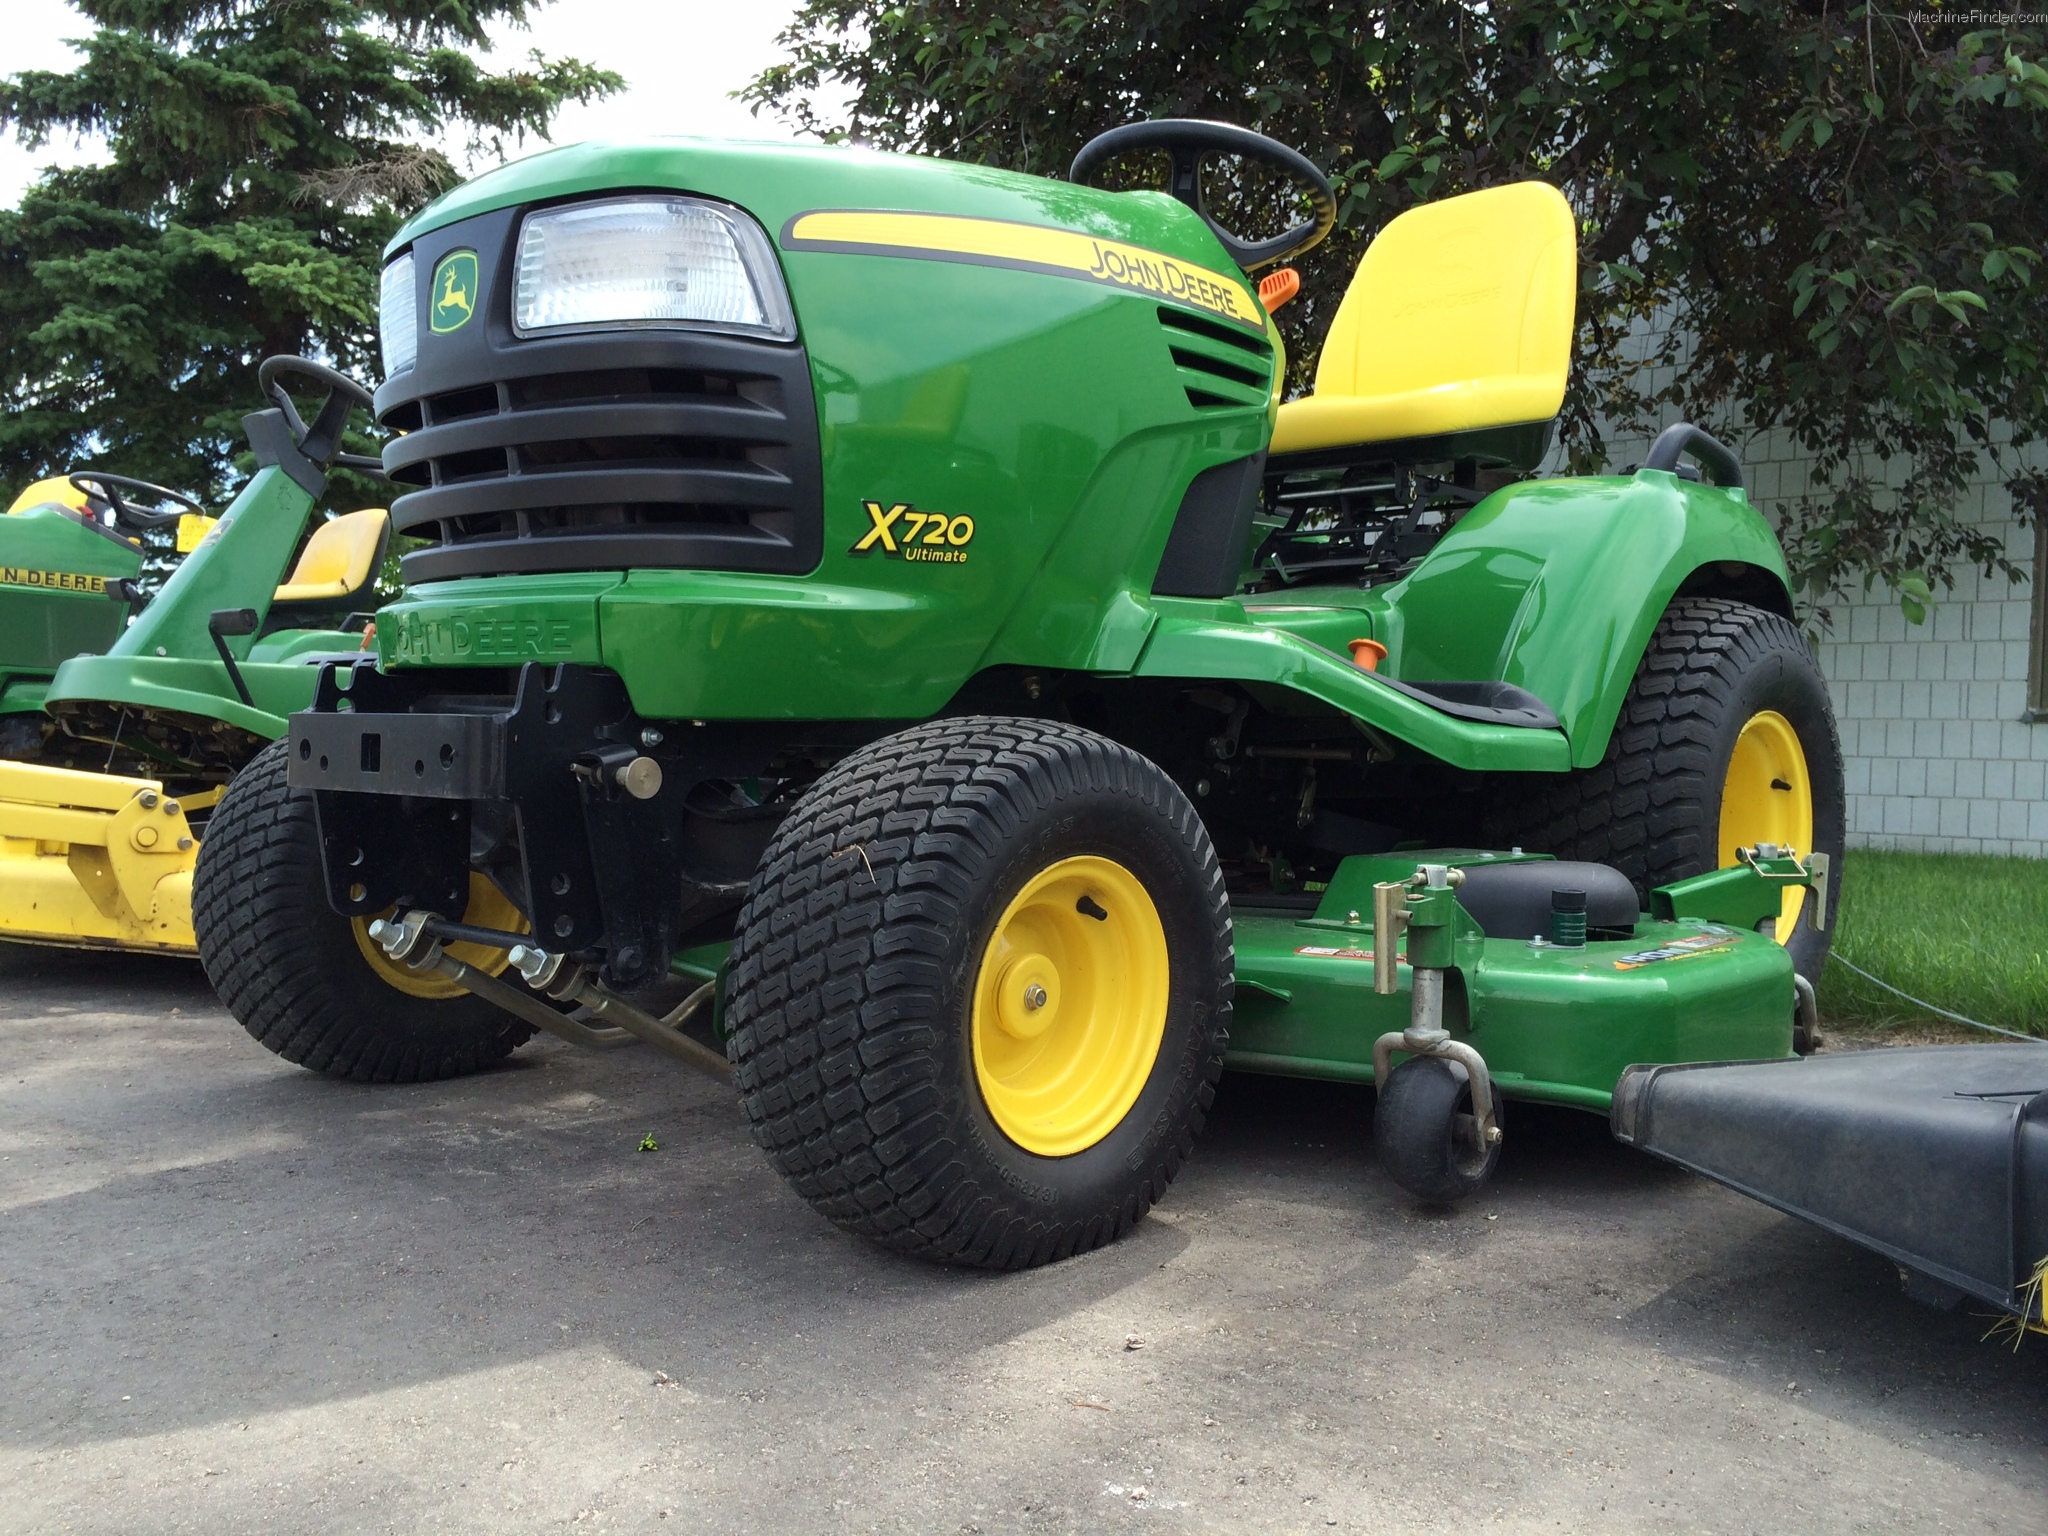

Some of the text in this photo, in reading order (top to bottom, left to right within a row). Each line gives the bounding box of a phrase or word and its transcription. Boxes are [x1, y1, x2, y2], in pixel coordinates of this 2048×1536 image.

[1090, 241, 1238, 314] JOHN DEERE
[852, 502, 974, 551] X720
[905, 547, 967, 562] Ultimate
[27, 570, 101, 591] DEERE
[450, 615, 573, 656] DEERE
